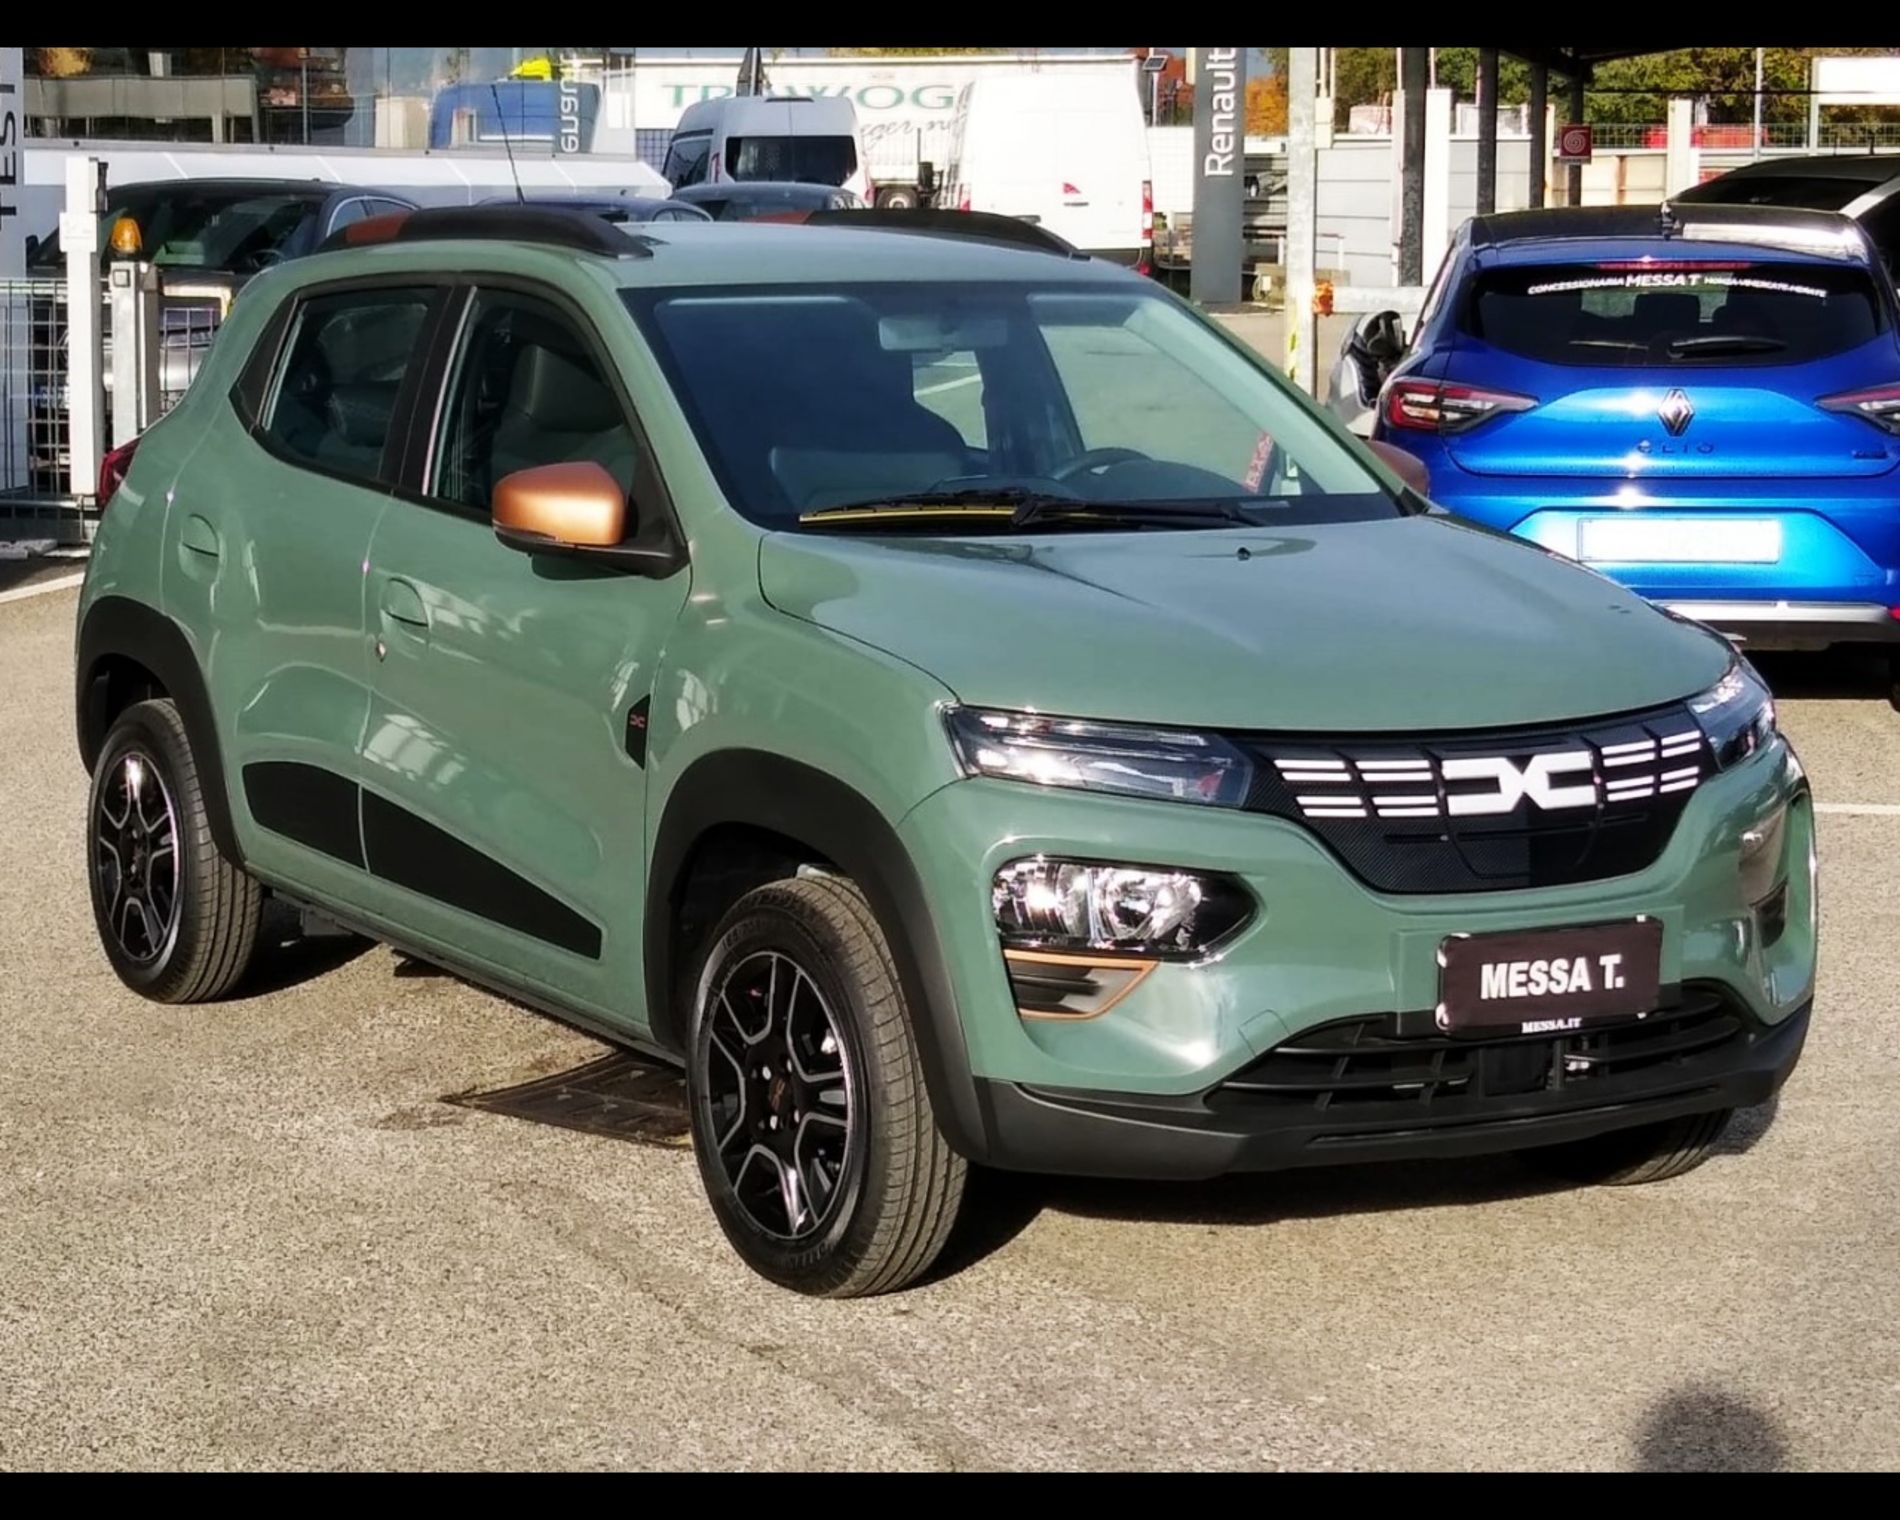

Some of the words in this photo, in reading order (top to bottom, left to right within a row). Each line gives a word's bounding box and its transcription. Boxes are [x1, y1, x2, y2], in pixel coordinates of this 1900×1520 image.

[1204, 48, 1236, 177] Renault
[1625, 274, 1686, 287] MESSA
[1480, 957, 1592, 1000] MESSA
[1599, 953, 1625, 990] T.
[1521, 1017, 1583, 1034] MESSA.IT
